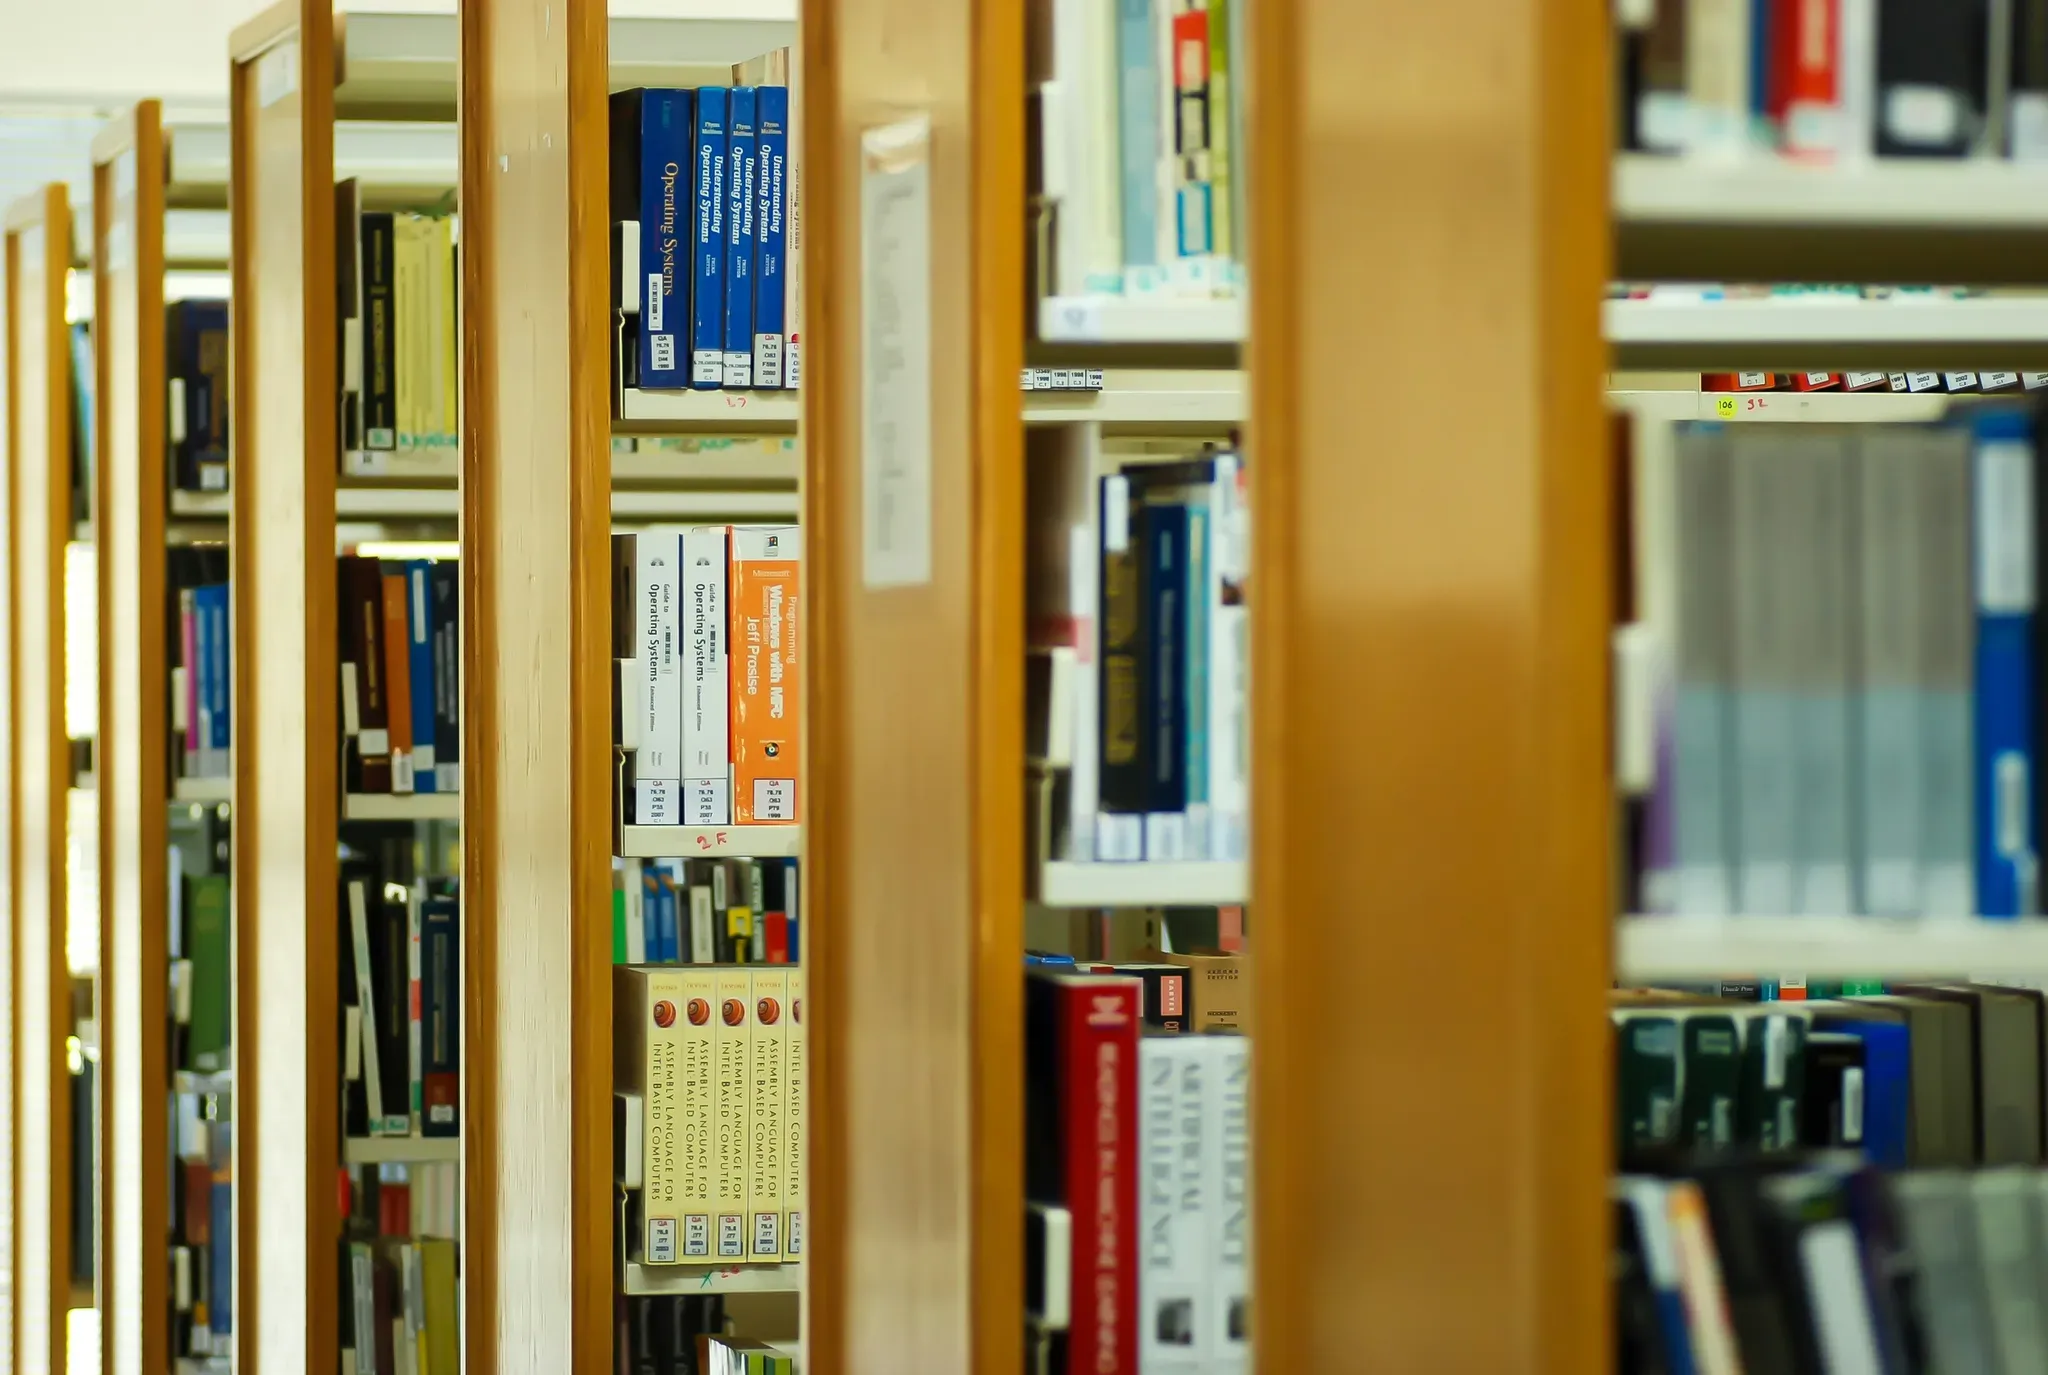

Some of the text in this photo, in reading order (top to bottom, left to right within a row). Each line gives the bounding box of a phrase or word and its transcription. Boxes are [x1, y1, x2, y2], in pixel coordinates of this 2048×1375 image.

[700, 145, 712, 197] Operating
[711, 156, 723, 233] Understanding
[731, 147, 743, 199] Operating
[742, 158, 754, 236] Understanding
[759, 145, 771, 243] Operating Systems
[770, 156, 782, 233] Understanding
[660, 162, 678, 296] Operating Systems
[700, 199, 711, 243] Systems
[731, 201, 742, 245] Systems
[1718, 400, 1732, 409] 106
[648, 584, 660, 636] Operating
[694, 584, 706, 635] Operating
[786, 596, 798, 664] Programming
[648, 640, 660, 682] Systems
[694, 640, 706, 682] Systems
[748, 616, 760, 695] Jeff Prosise
[770, 584, 784, 719] Windows with MFC
[664, 1042, 674, 1202] ASSEMBLY LANGUAGE FOR
[698, 1040, 708, 1200] ASSEMBLY LANGUAGE FOR
[733, 1040, 744, 1200] ASSEMBLY LANGUAGE FOR
[768, 1038, 778, 1198] ASSEMBLY LANGUAGE FOR
[652, 1126, 662, 1200] COMPUTERS
[686, 1124, 695, 1198] COMPUTERS
[720, 1125, 730, 1198] COMPUTERS
[755, 1122, 765, 1196] COMPUTERS
[790, 1122, 800, 1196] COMPUTERS
